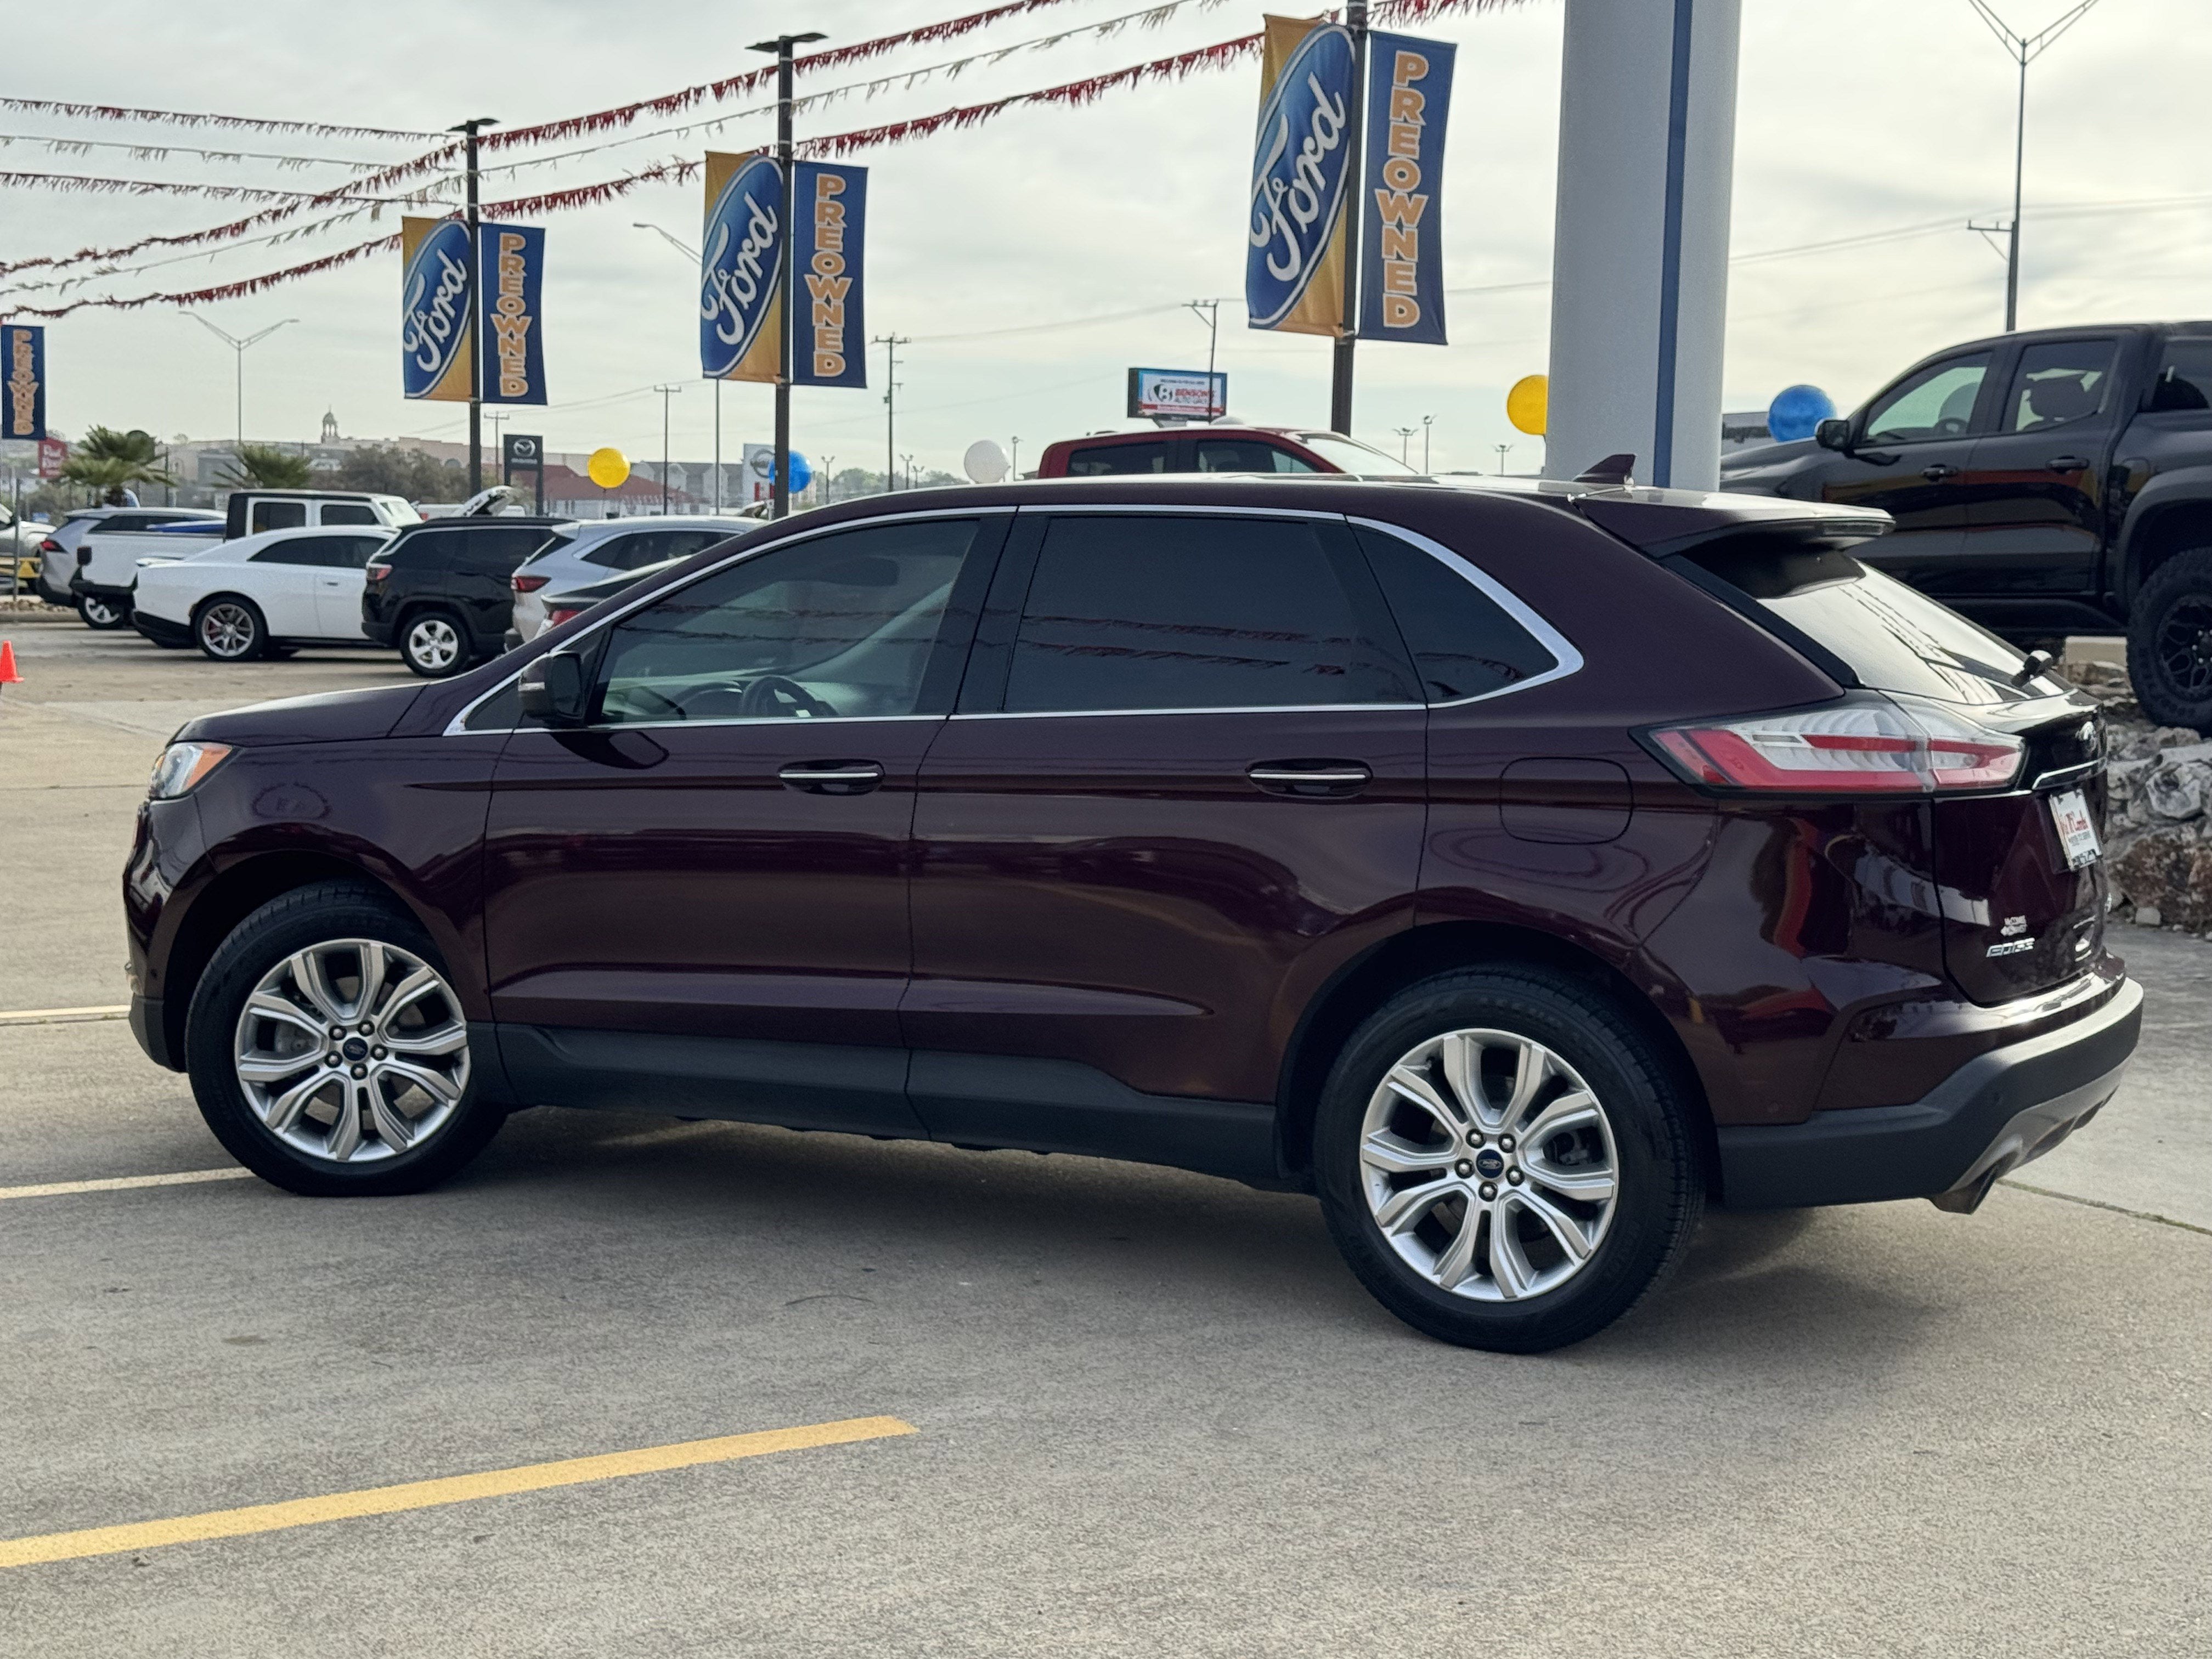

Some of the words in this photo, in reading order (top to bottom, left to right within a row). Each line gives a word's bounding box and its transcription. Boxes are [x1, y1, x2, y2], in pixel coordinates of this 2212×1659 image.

[701, 191, 778, 345] Ford
[1250, 72, 1346, 281] Ford
[1375, 50, 1430, 328] PREOWNED
[403, 249, 467, 373] Ford
[490, 232, 533, 397] PREOWNED
[804, 173, 854, 377] PREOWNED
